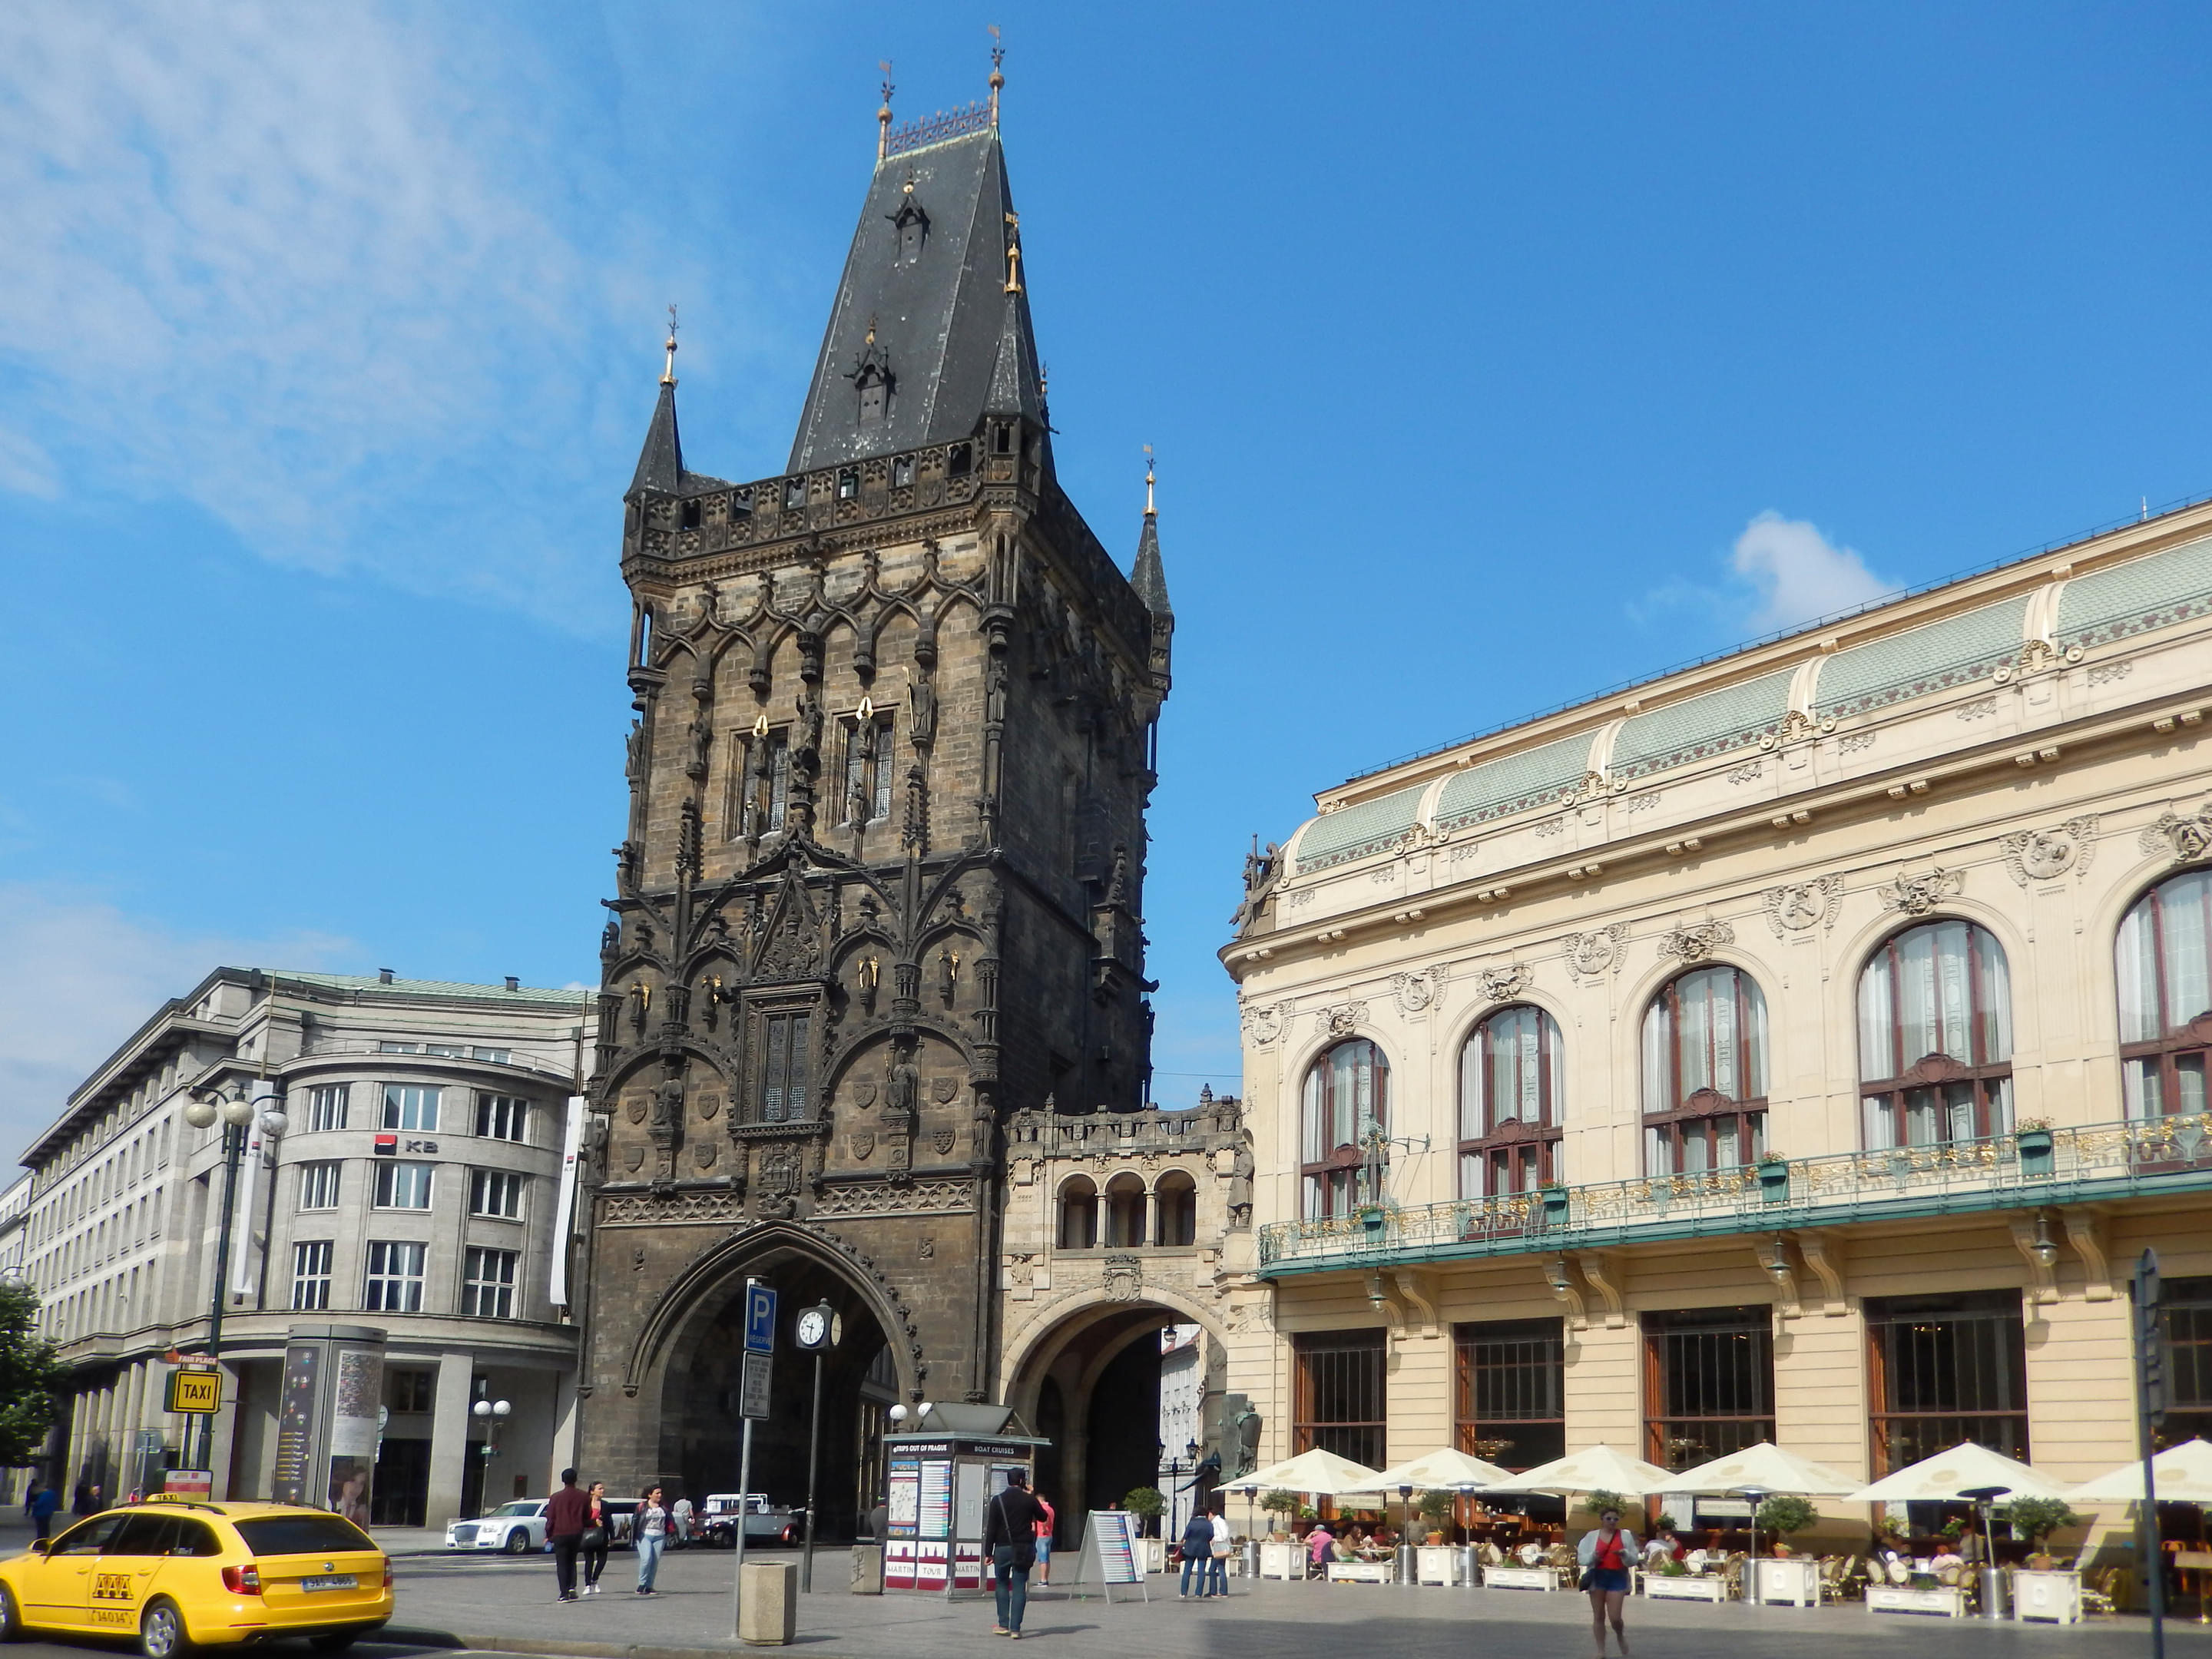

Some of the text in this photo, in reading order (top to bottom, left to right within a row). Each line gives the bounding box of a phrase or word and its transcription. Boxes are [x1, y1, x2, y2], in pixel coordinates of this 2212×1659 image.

[406, 1140, 439, 1154] KB
[753, 1294, 770, 1330] P
[184, 1384, 211, 1399] TAXI
[887, 1565, 942, 1575] MARTIN TOUR
[955, 1565, 980, 1574] MARTIN
[92, 1574, 134, 1600] AAA
